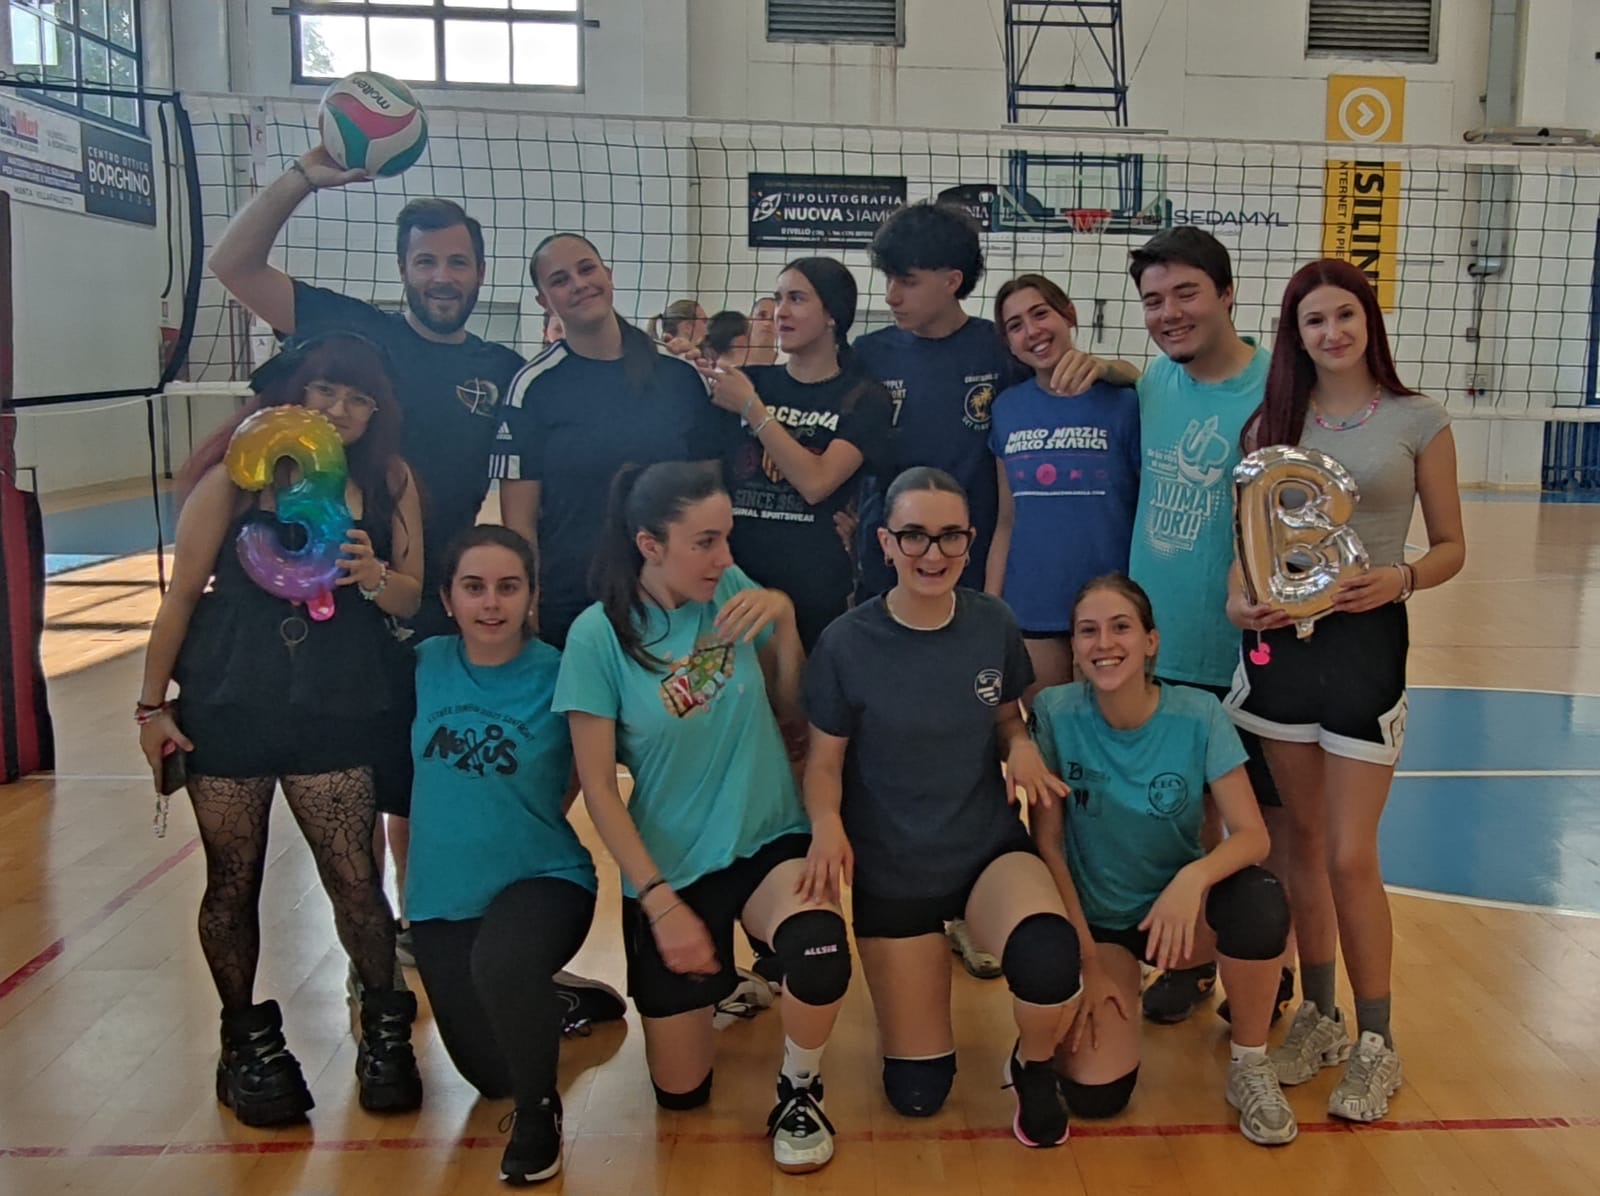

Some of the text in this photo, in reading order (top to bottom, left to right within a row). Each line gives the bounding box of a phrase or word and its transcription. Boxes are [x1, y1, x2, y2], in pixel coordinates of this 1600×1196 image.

[352, 77, 391, 110] molten
[88, 146, 149, 173] CENTRO OTTICO
[88, 159, 150, 196] BORGHINO
[784, 193, 902, 206] TIPOLITOGRAFIA
[784, 207, 843, 221] NUOVA
[1174, 210, 1288, 227] SEDAMYL
[1334, 161, 1349, 262] NTERNET IN PIE
[1351, 161, 1384, 298] ISILIN
[1004, 438, 1108, 455] MARCO SKARICA
[1007, 428, 1049, 443] MARCO
